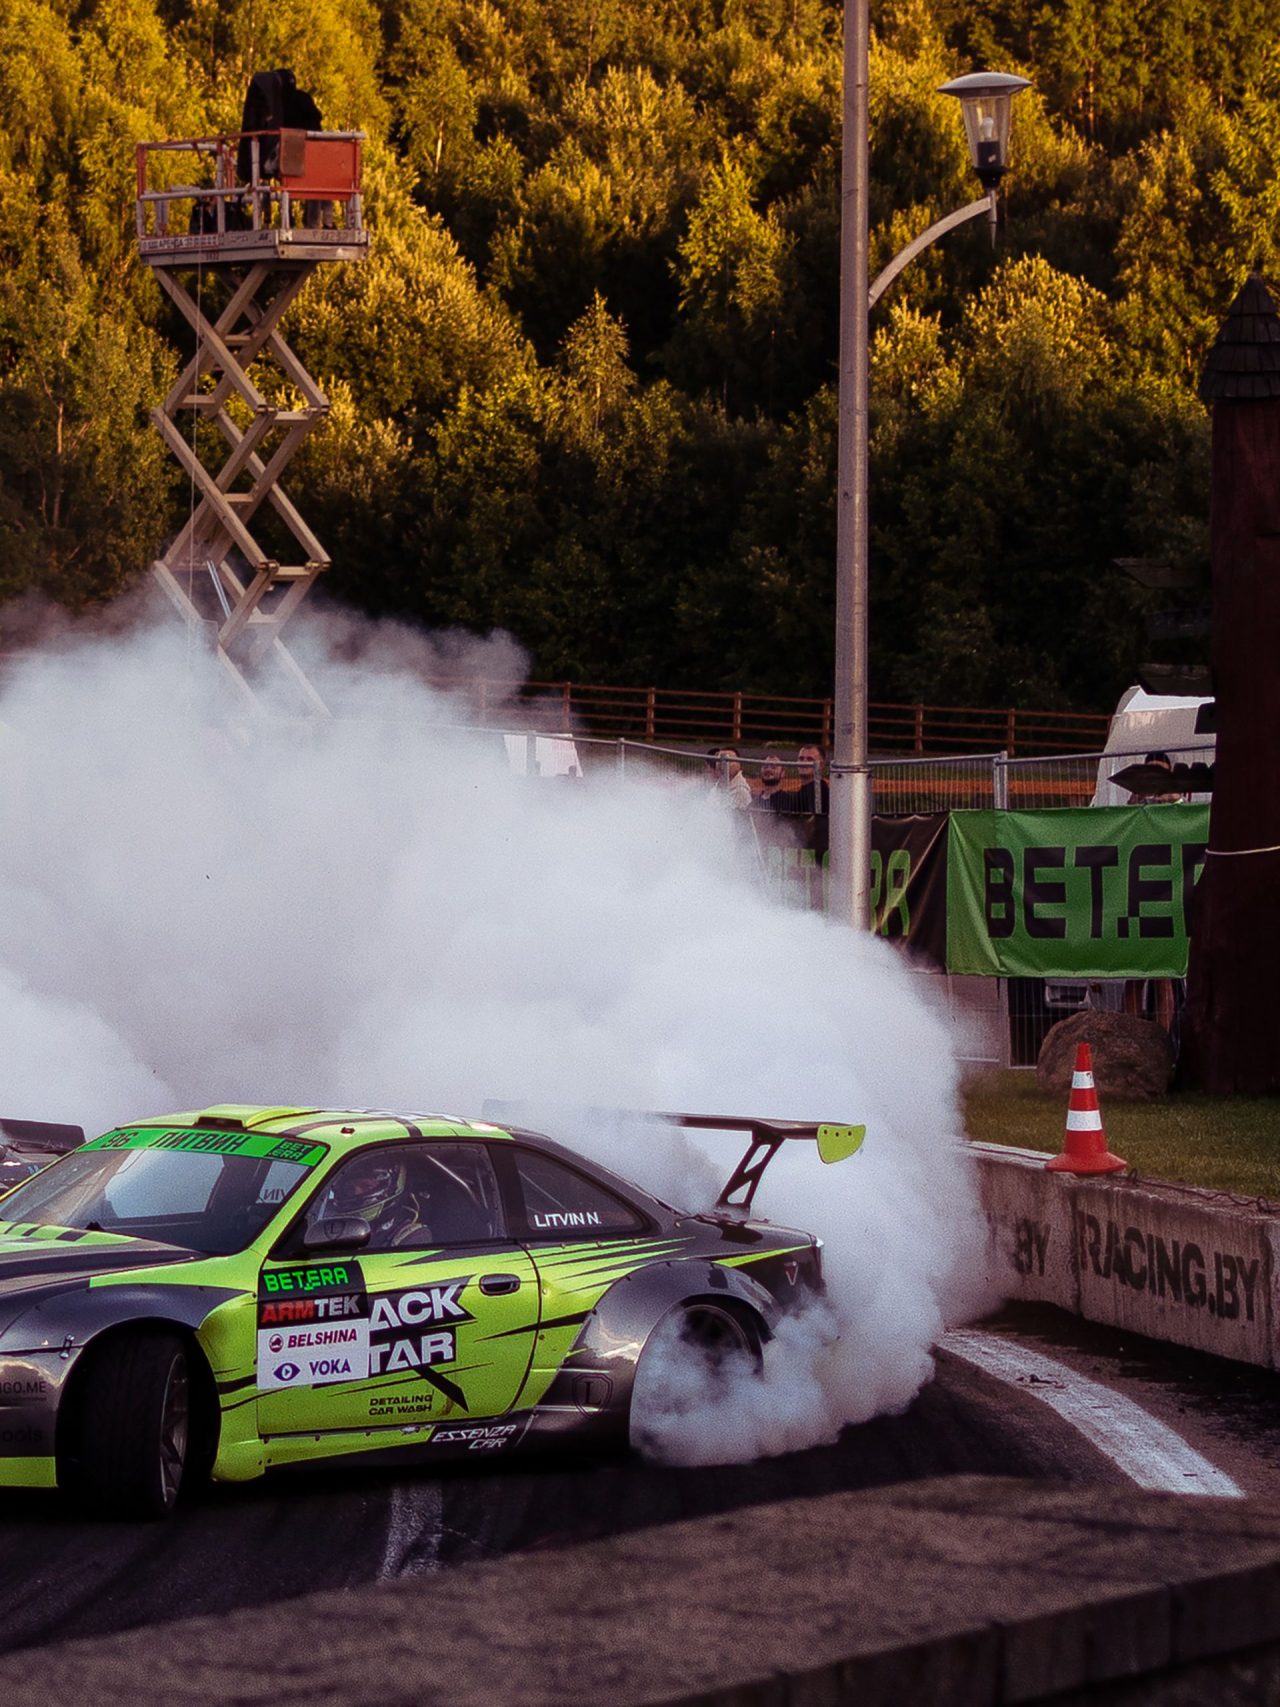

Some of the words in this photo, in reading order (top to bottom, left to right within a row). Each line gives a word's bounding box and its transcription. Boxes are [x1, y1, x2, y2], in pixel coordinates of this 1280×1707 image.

[148, 1131, 253, 1153] ЛИТВИН
[534, 1212, 586, 1229] LITVIN
[1077, 1210, 1260, 1321] RACING.BY
[263, 1266, 350, 1292] BETERA
[261, 1294, 361, 1324] ARMTEK
[370, 1282, 468, 1332] ACK
[287, 1328, 358, 1349] BELSHINA
[368, 1331, 455, 1374] TAR
[309, 1358, 352, 1376] VOKA
[368, 1405, 393, 1416] CAR
[396, 1403, 433, 1415] WASH
[369, 1393, 434, 1407] DETAILING
[432, 1424, 517, 1443] ESSENZA
[468, 1437, 508, 1450] CAR
